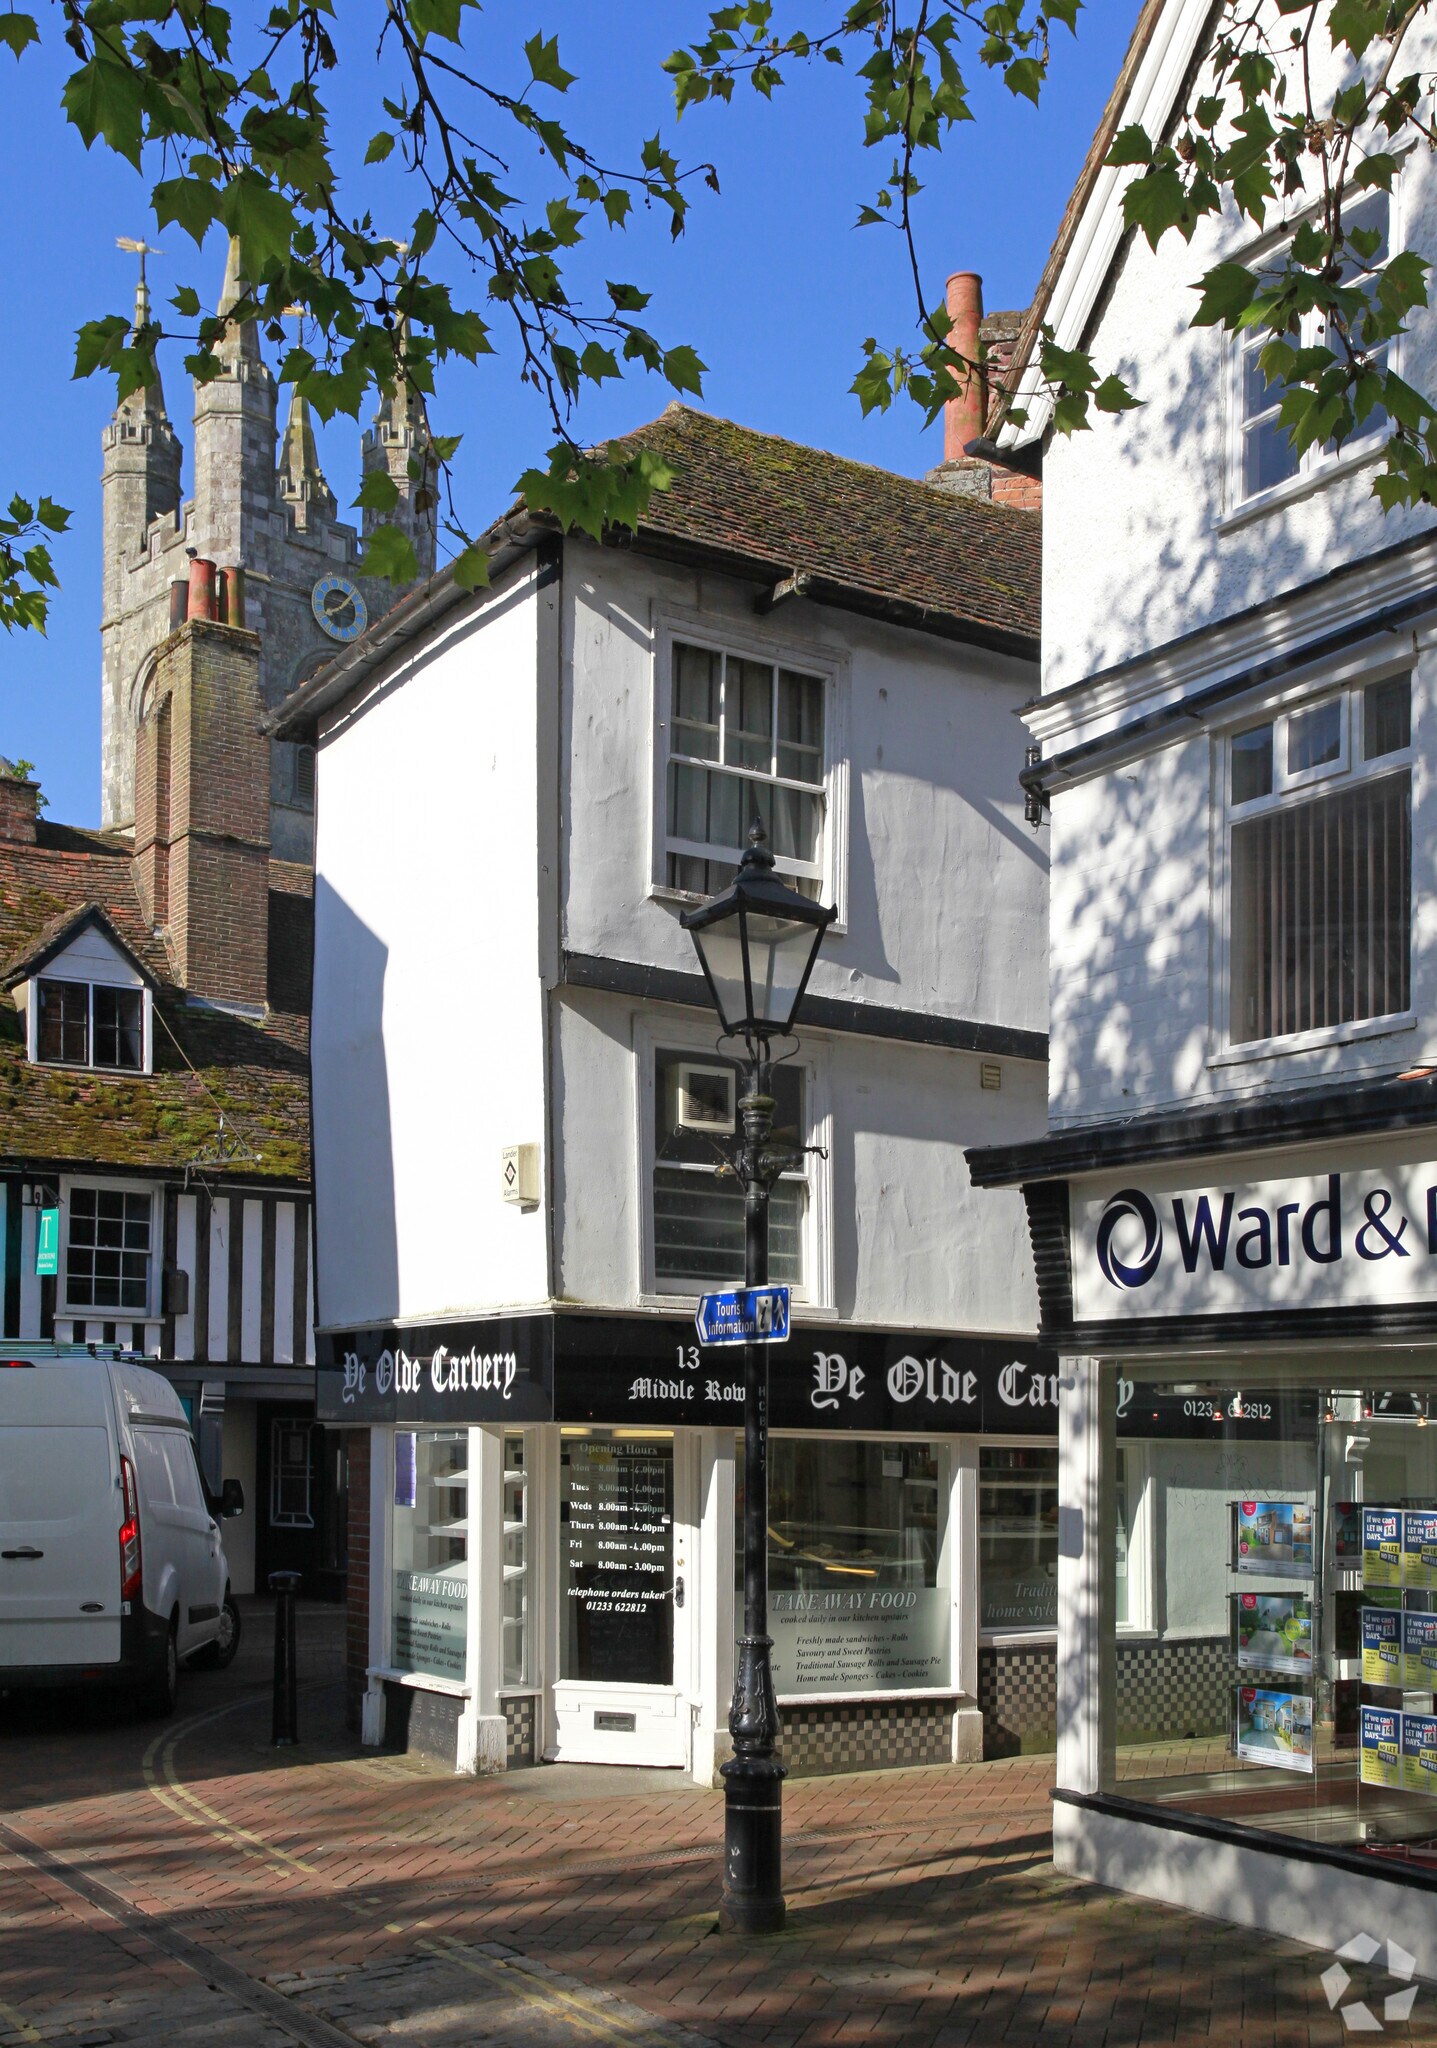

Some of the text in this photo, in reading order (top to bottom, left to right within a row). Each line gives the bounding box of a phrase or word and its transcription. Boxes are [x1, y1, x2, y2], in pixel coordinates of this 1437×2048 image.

[1172, 1173, 1342, 1273] Ward
[1355, 1189, 1411, 1261] &
[716, 1301, 745, 1317] Tourist
[708, 1319, 755, 1336] information
[677, 1346, 700, 1369] 13
[342, 1345, 516, 1403] Ye Olde Carvery
[811, 1351, 865, 1409] Ye
[887, 1355, 978, 1404] Olde
[628, 1377, 746, 1401] Middle Row
[1183, 1400, 1271, 1419] 0123 62812
[580, 1443, 658, 1456] Opening Hours
[572, 1464, 590, 1472] Mon
[571, 1482, 590, 1491] Tues
[570, 1502, 592, 1510] Weds
[598, 1503, 628, 1511] 8.00am
[569, 1520, 594, 1529] Thurs
[598, 1522, 628, 1531] 8.00am
[569, 1540, 582, 1548] Fri
[598, 1541, 627, 1550] 8.00am
[569, 1560, 665, 1573] Sat 8.00am 3.00pm
[567, 1587, 665, 1600] telephone orders taken
[586, 1601, 647, 1613] 01233 622812
[870, 1592, 917, 1609] FOOD
[987, 1601, 1057, 1620] home style
[780, 1614, 807, 1624] cooked
[809, 1614, 826, 1625] daily
[828, 1614, 836, 1622] in
[853, 1613, 879, 1622] kitchen
[881, 1613, 909, 1623] upstairs
[796, 1633, 909, 1646] Freshly made sandwiches Rolls
[796, 1647, 891, 1659] Savoury and Sweet Pastries
[796, 1656, 941, 1670] Traditional Sausage Rolls and Sausage Pie
[796, 1669, 928, 1683] Home made Sponges Cakes Cookies
